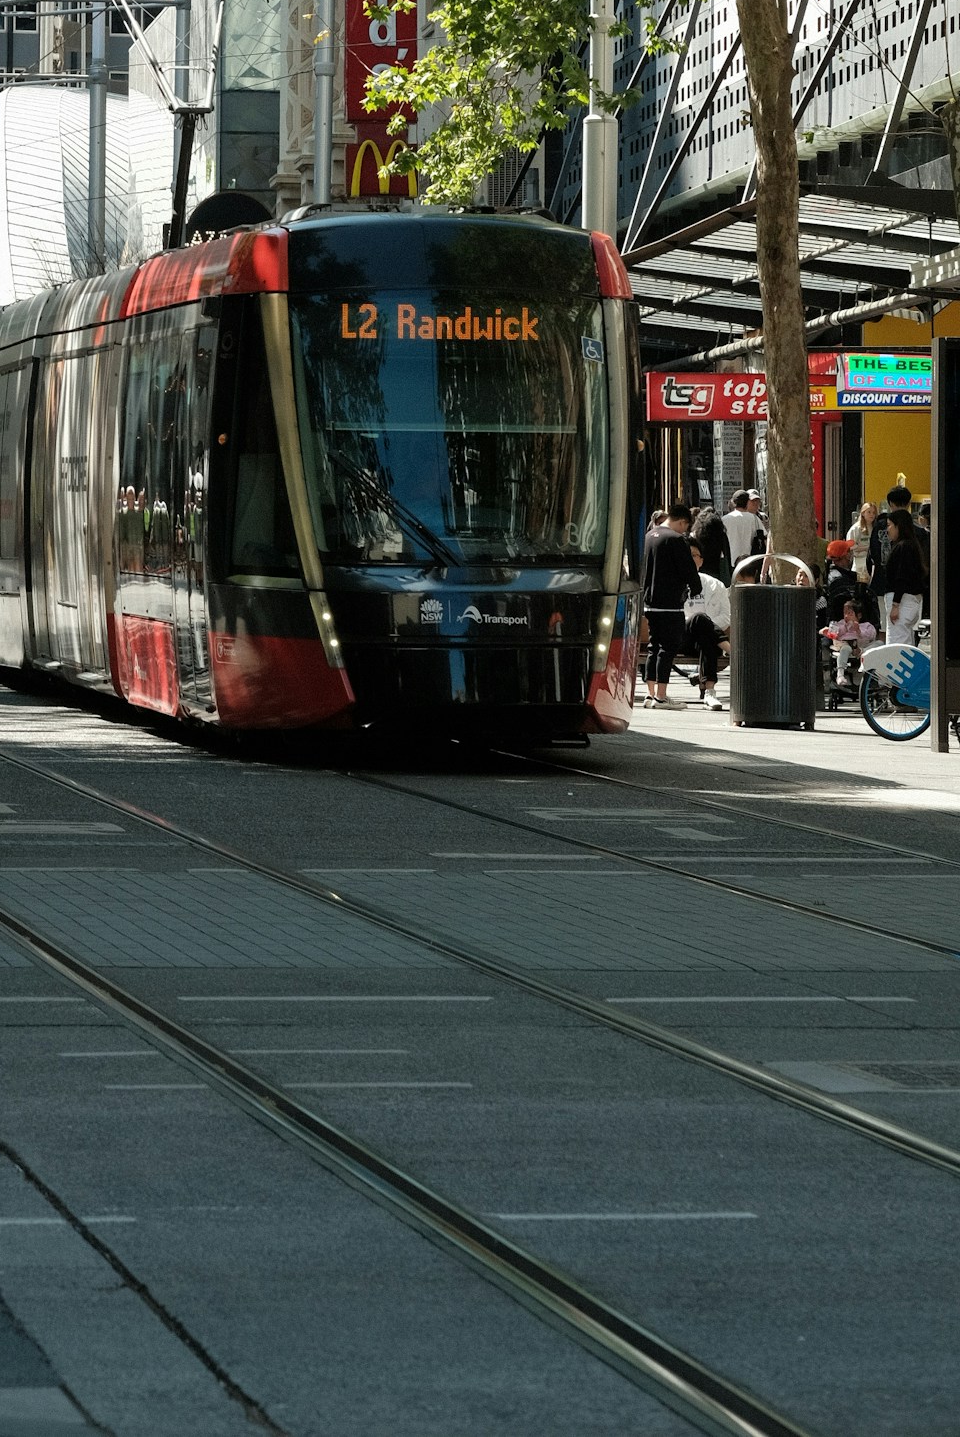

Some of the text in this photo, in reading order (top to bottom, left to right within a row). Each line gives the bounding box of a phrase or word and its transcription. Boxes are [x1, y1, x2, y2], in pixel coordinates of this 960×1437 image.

[341, 303, 539, 341] L2 Randwick
[852, 358, 931, 371] THE BES
[853, 374, 877, 385] OF
[661, 376, 767, 417] tsg tob
[842, 393, 932, 404] DISCOUNT CHEM
[420, 612, 443, 621] NSW
[482, 614, 528, 626] Transport
